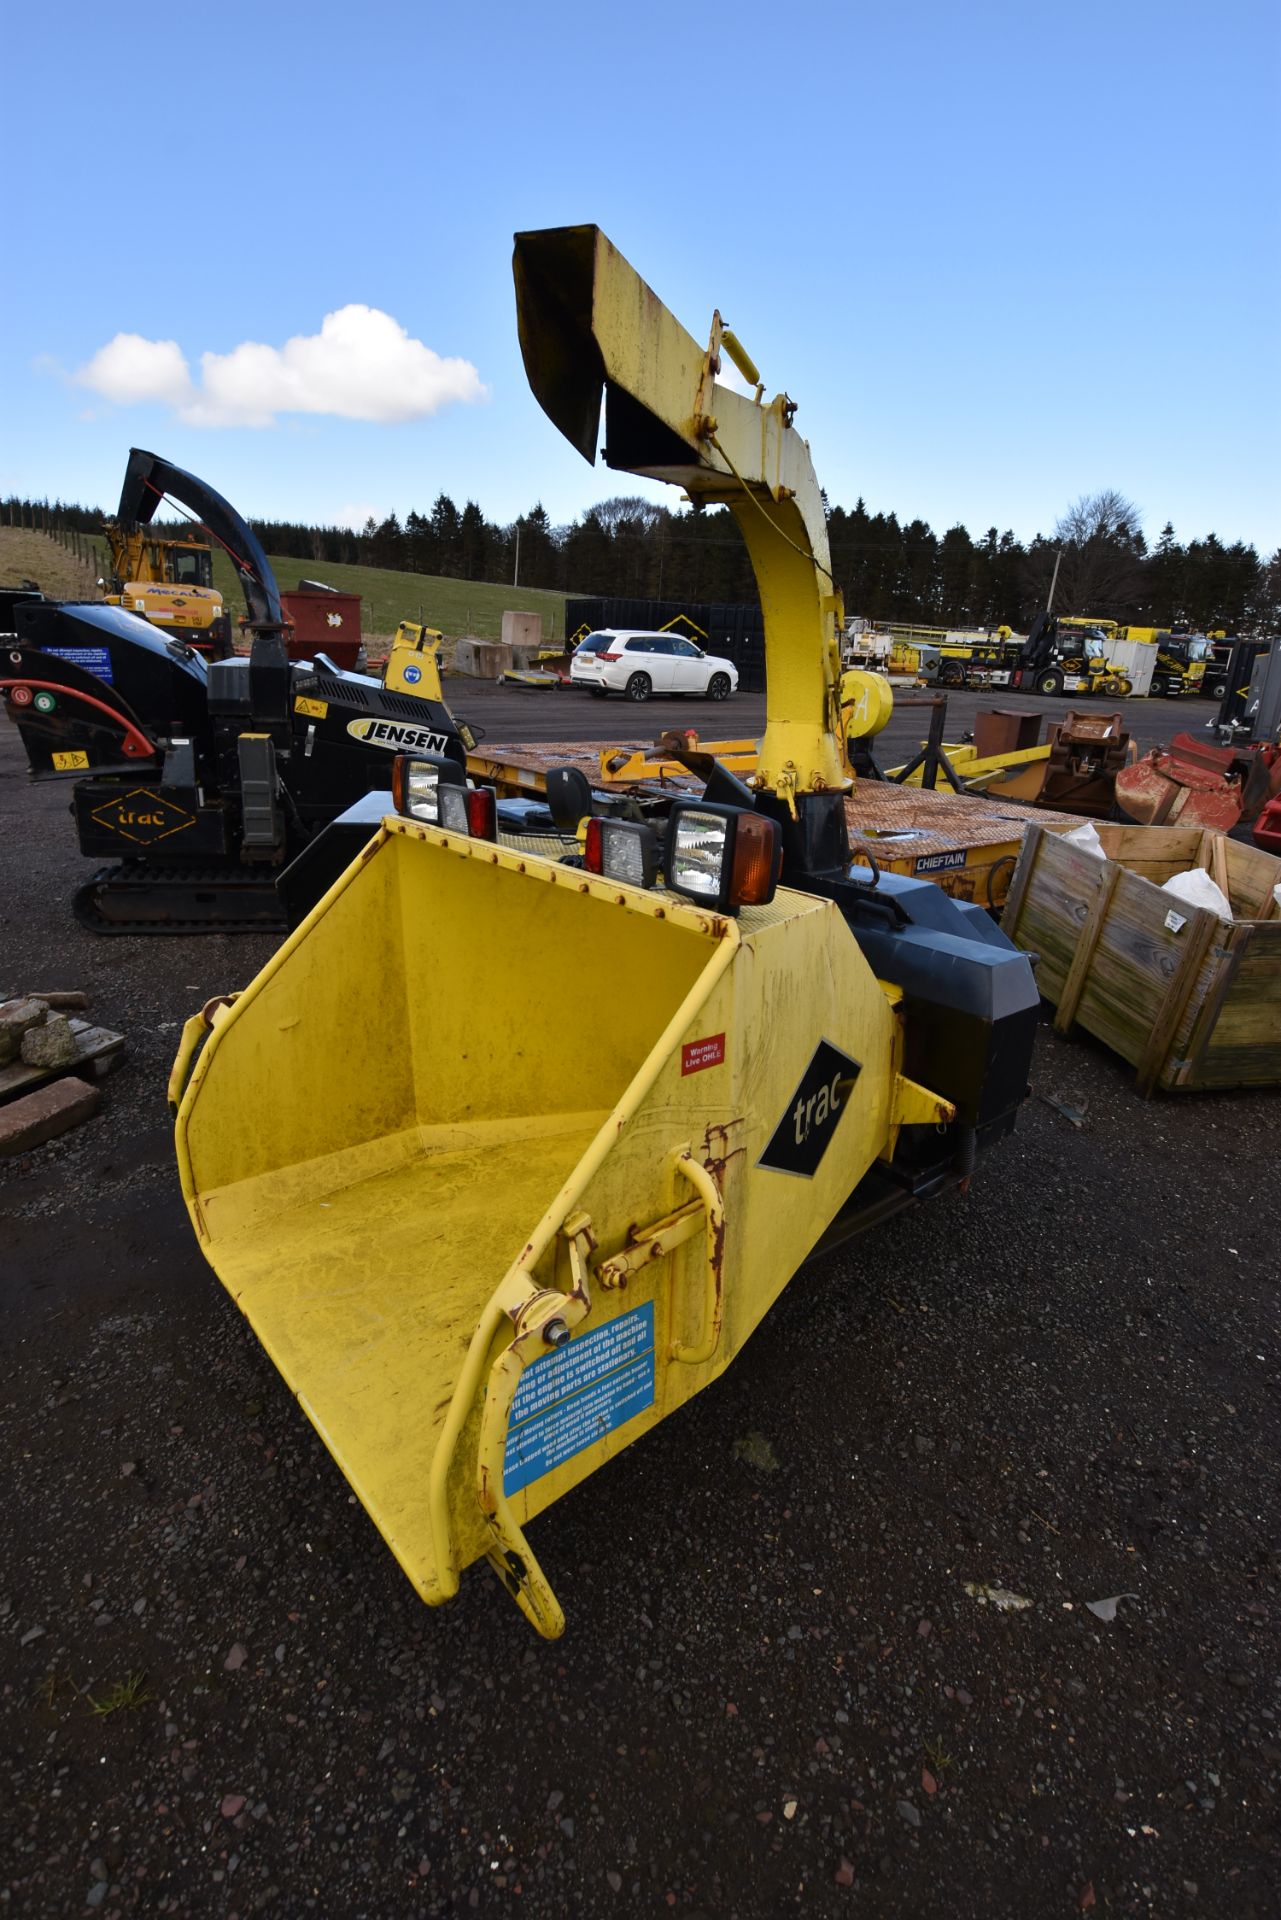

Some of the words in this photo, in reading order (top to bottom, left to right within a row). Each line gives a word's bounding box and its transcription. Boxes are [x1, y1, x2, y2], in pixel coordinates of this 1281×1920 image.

[855, 688, 869, 721] A
[362, 722, 449, 752] JENSEN
[118, 806, 165, 826] trac
[917, 852, 965, 870] CHIEFTAIN
[685, 1058, 701, 1068] Live
[702, 1050, 722, 1063] OHLE
[690, 1041, 718, 1057] Warning
[793, 1071, 841, 1145] trac
[534, 1352, 565, 1372] attempt
[567, 1329, 610, 1354] inspection,
[611, 1314, 639, 1332] repairs,
[537, 1374, 545, 1384] or
[547, 1350, 591, 1377] adjustment
[593, 1344, 600, 1353] of
[602, 1337, 614, 1349] the
[615, 1321, 647, 1341] machine
[522, 1390, 535, 1404] the
[537, 1376, 564, 1395] engine
[566, 1369, 573, 1379] is
[575, 1351, 609, 1374] switched
[611, 1344, 620, 1355] off
[622, 1336, 635, 1348] and
[637, 1330, 646, 1341] all
[514, 1407, 528, 1420] the
[530, 1390, 559, 1411] moving
[561, 1378, 581, 1394] parts
[583, 1370, 595, 1381] are
[597, 1349, 635, 1373] stationary.
